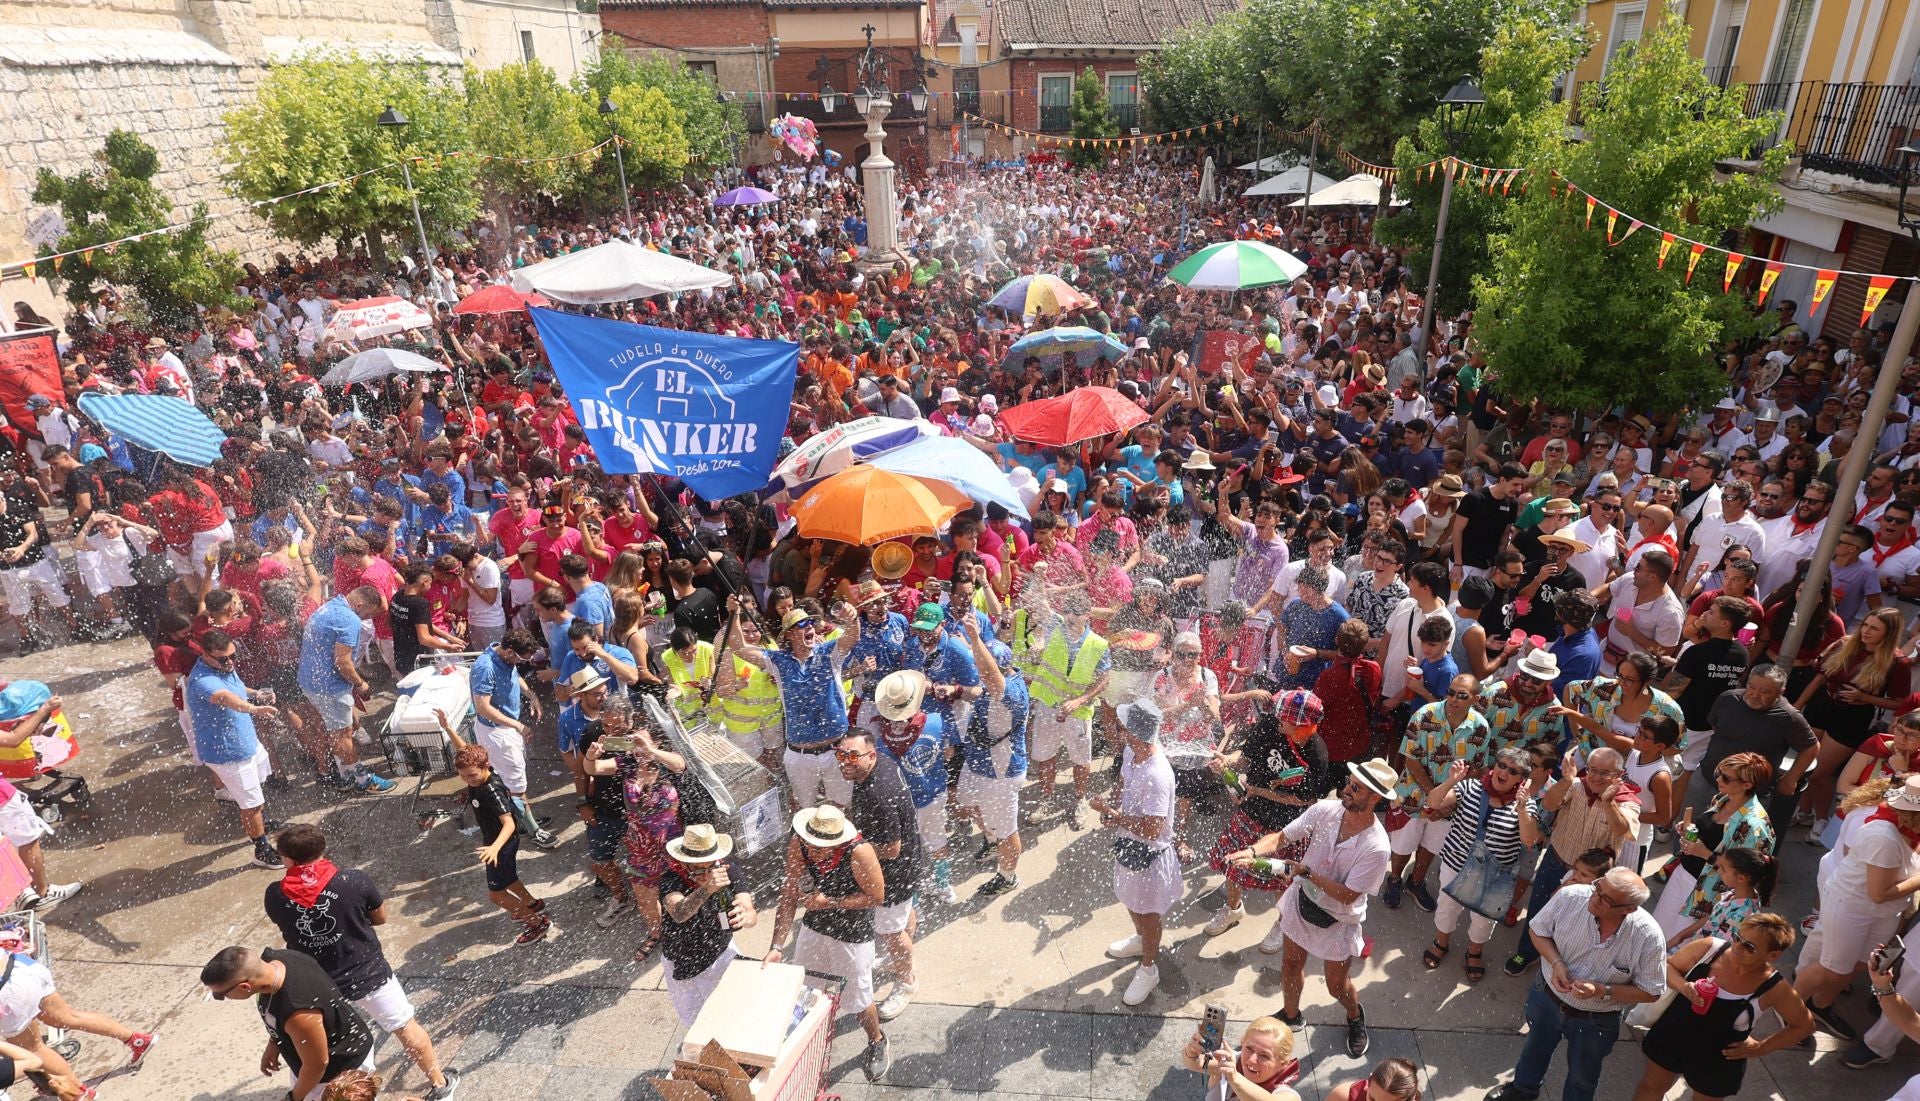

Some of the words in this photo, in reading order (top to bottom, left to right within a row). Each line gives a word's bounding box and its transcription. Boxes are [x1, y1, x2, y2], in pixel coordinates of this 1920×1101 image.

[609, 342, 663, 369] TUDELA
[671, 343, 688, 356] de
[695, 349, 734, 381] DUERO
[655, 368, 694, 395] EL
[674, 461, 709, 477] Desde
[712, 459, 742, 471] 2012
[308, 933, 343, 948] COGORZA
